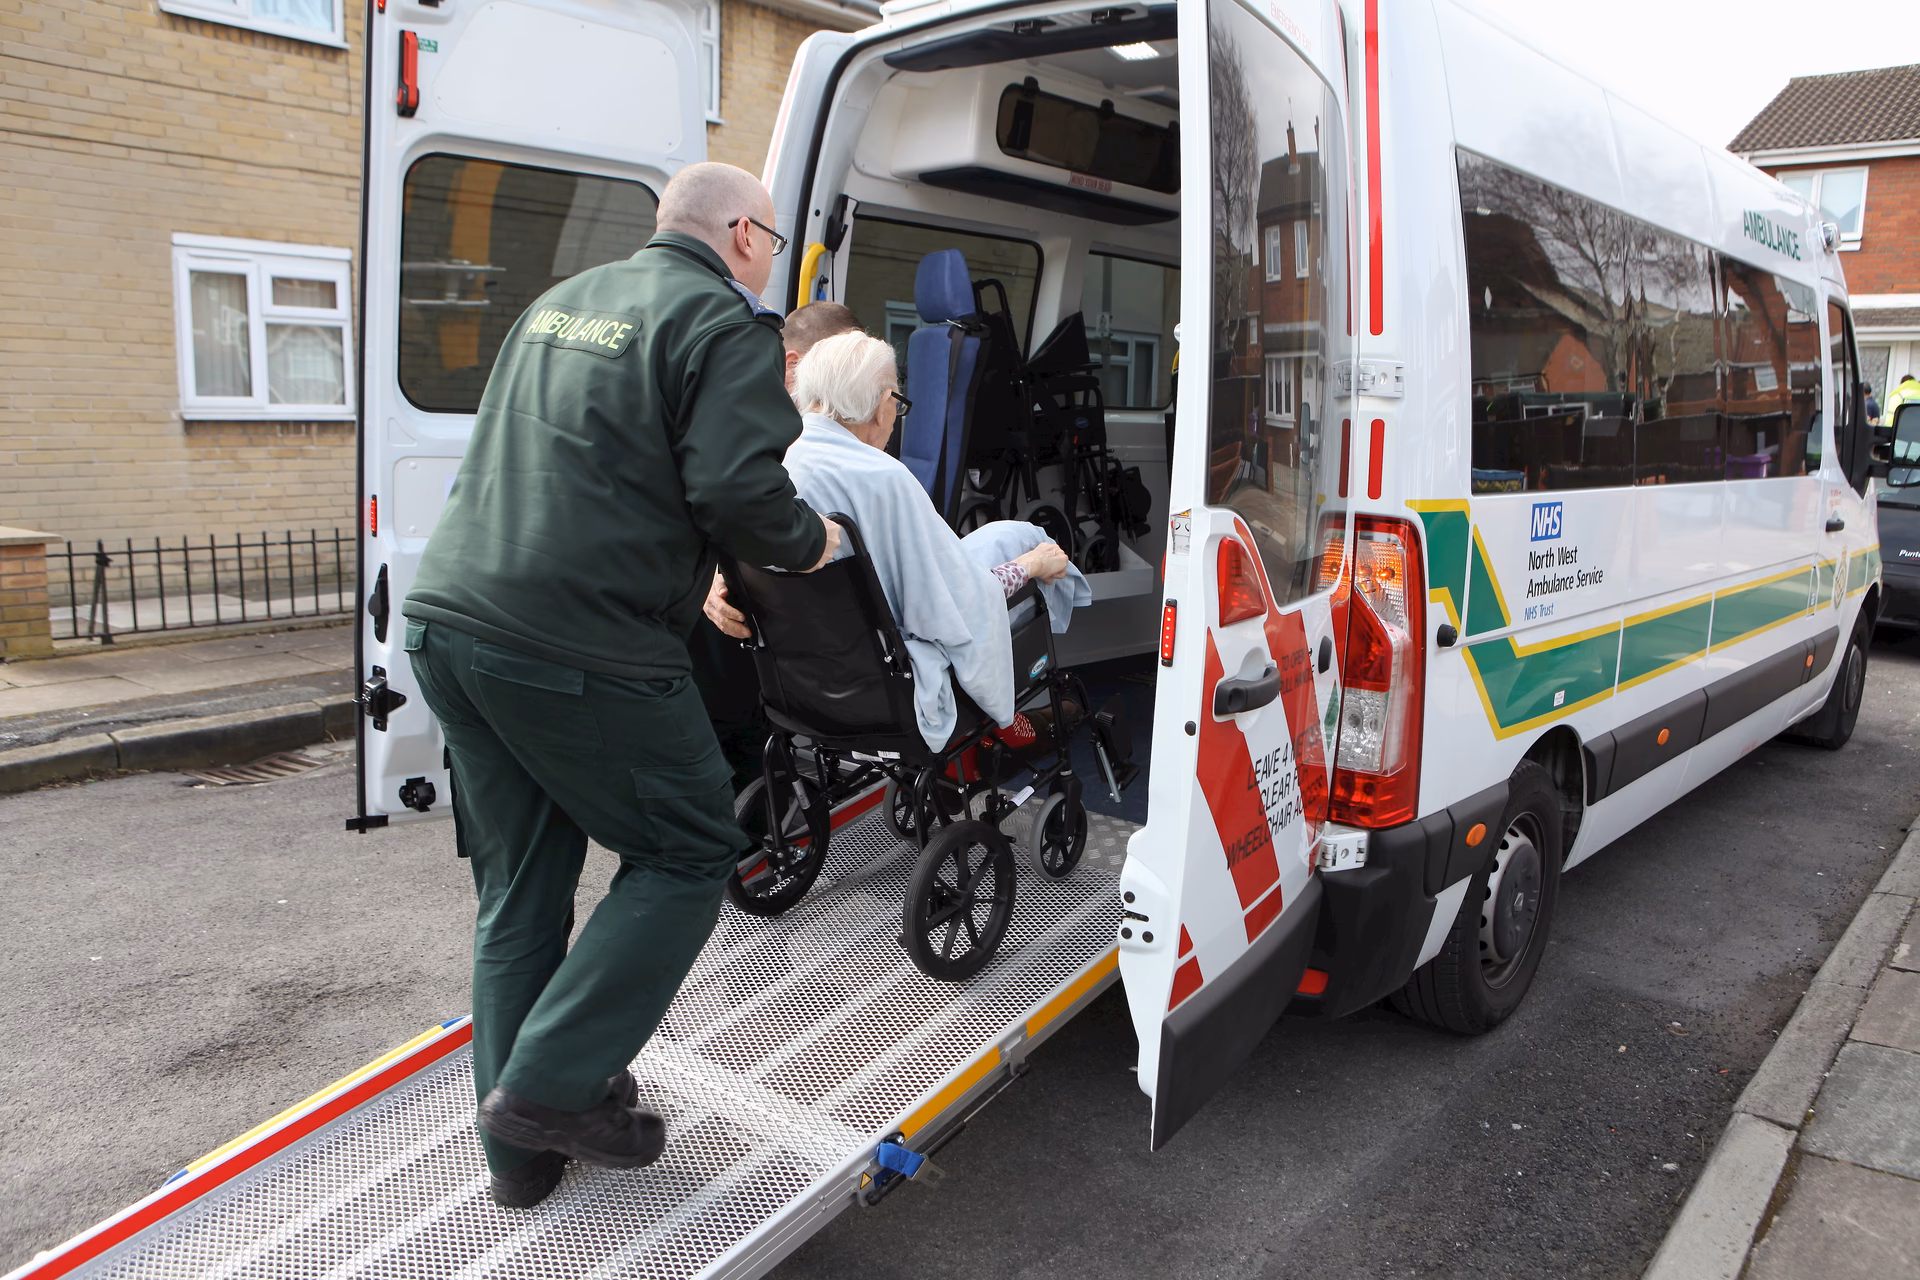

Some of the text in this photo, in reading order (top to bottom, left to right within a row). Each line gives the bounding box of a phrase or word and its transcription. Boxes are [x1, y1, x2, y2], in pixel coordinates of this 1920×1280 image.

[1271, 1, 1312, 54] EMERGENCY EXIT
[1071, 175, 1112, 193] MIND YOUR HEAD
[1743, 208, 1801, 261] AMBULANCE
[526, 310, 634, 350] AMBULANCE
[1531, 504, 1562, 538] NHS
[1528, 545, 1578, 571] North West
[1526, 566, 1604, 599] Ambulance Service
[1524, 603, 1554, 621] NHS Trust
[1281, 654, 1289, 671] TO
[1247, 746, 1281, 790] LEAVE
[1282, 743, 1289, 767] 4
[1258, 773, 1291, 816] CLEAR
[1227, 804, 1291, 870] WHEELCHAIR
